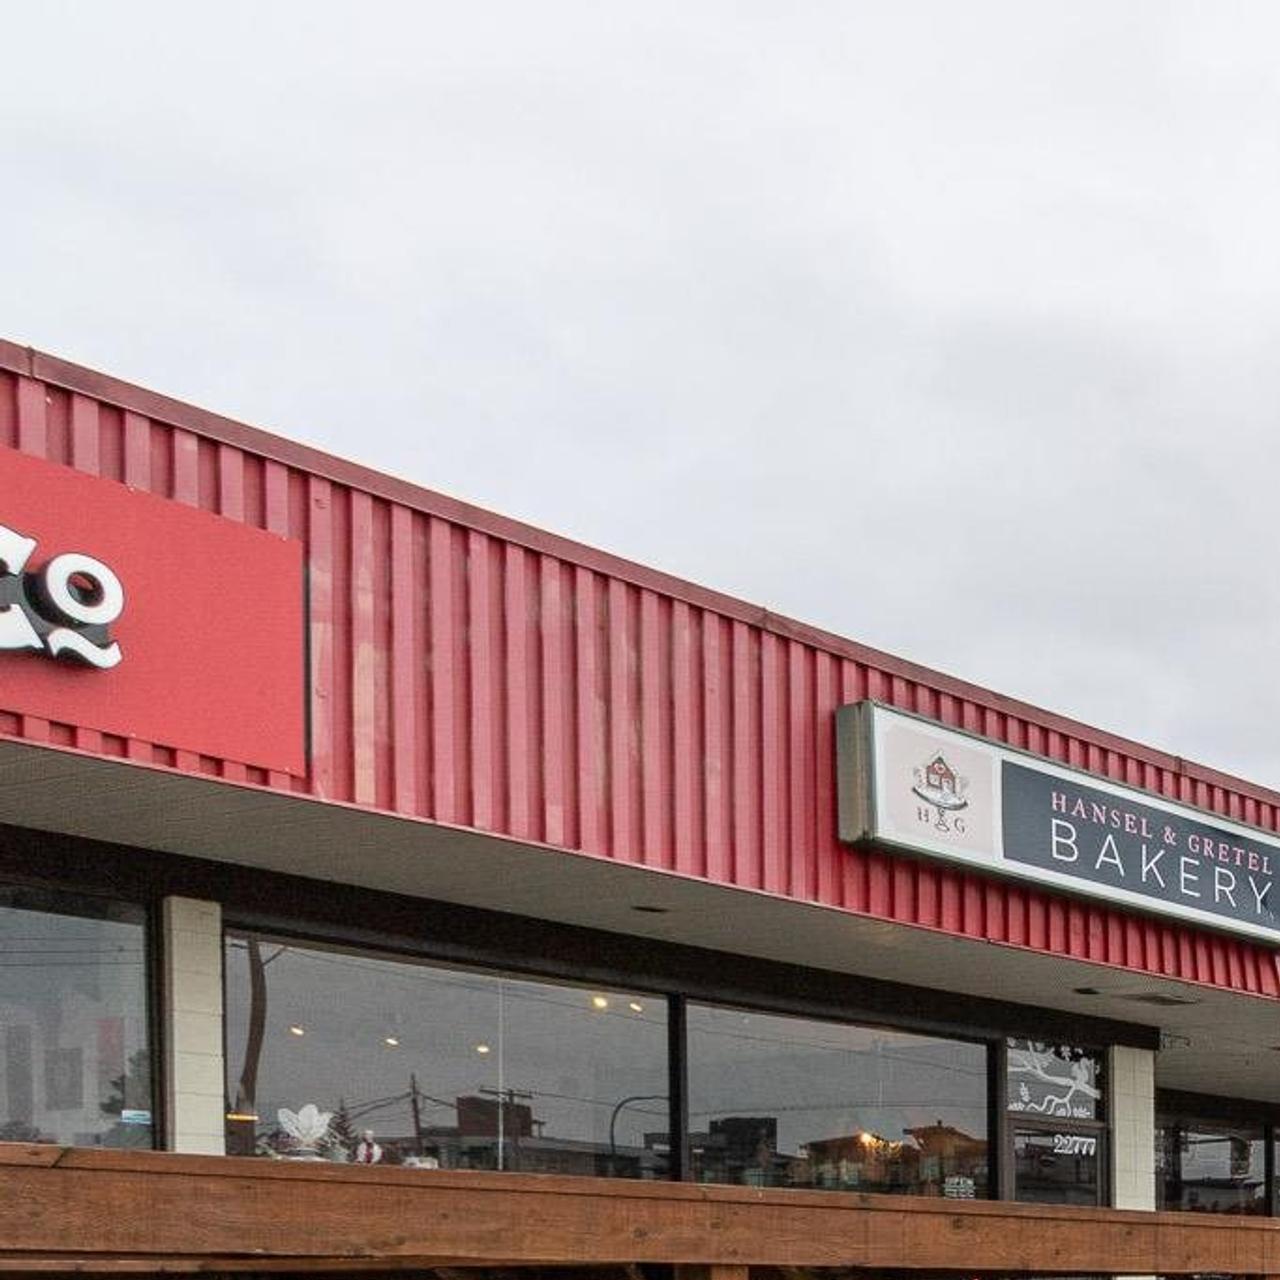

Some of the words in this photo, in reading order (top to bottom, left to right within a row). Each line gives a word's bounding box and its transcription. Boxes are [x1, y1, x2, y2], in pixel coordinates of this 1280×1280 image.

[1051, 791, 1152, 838] HANSEL
[1163, 825, 1177, 846] &
[1188, 833, 1273, 875] GRETEL
[1051, 817, 1273, 914] BAKERY
[1053, 1133, 1097, 1157] 22777
